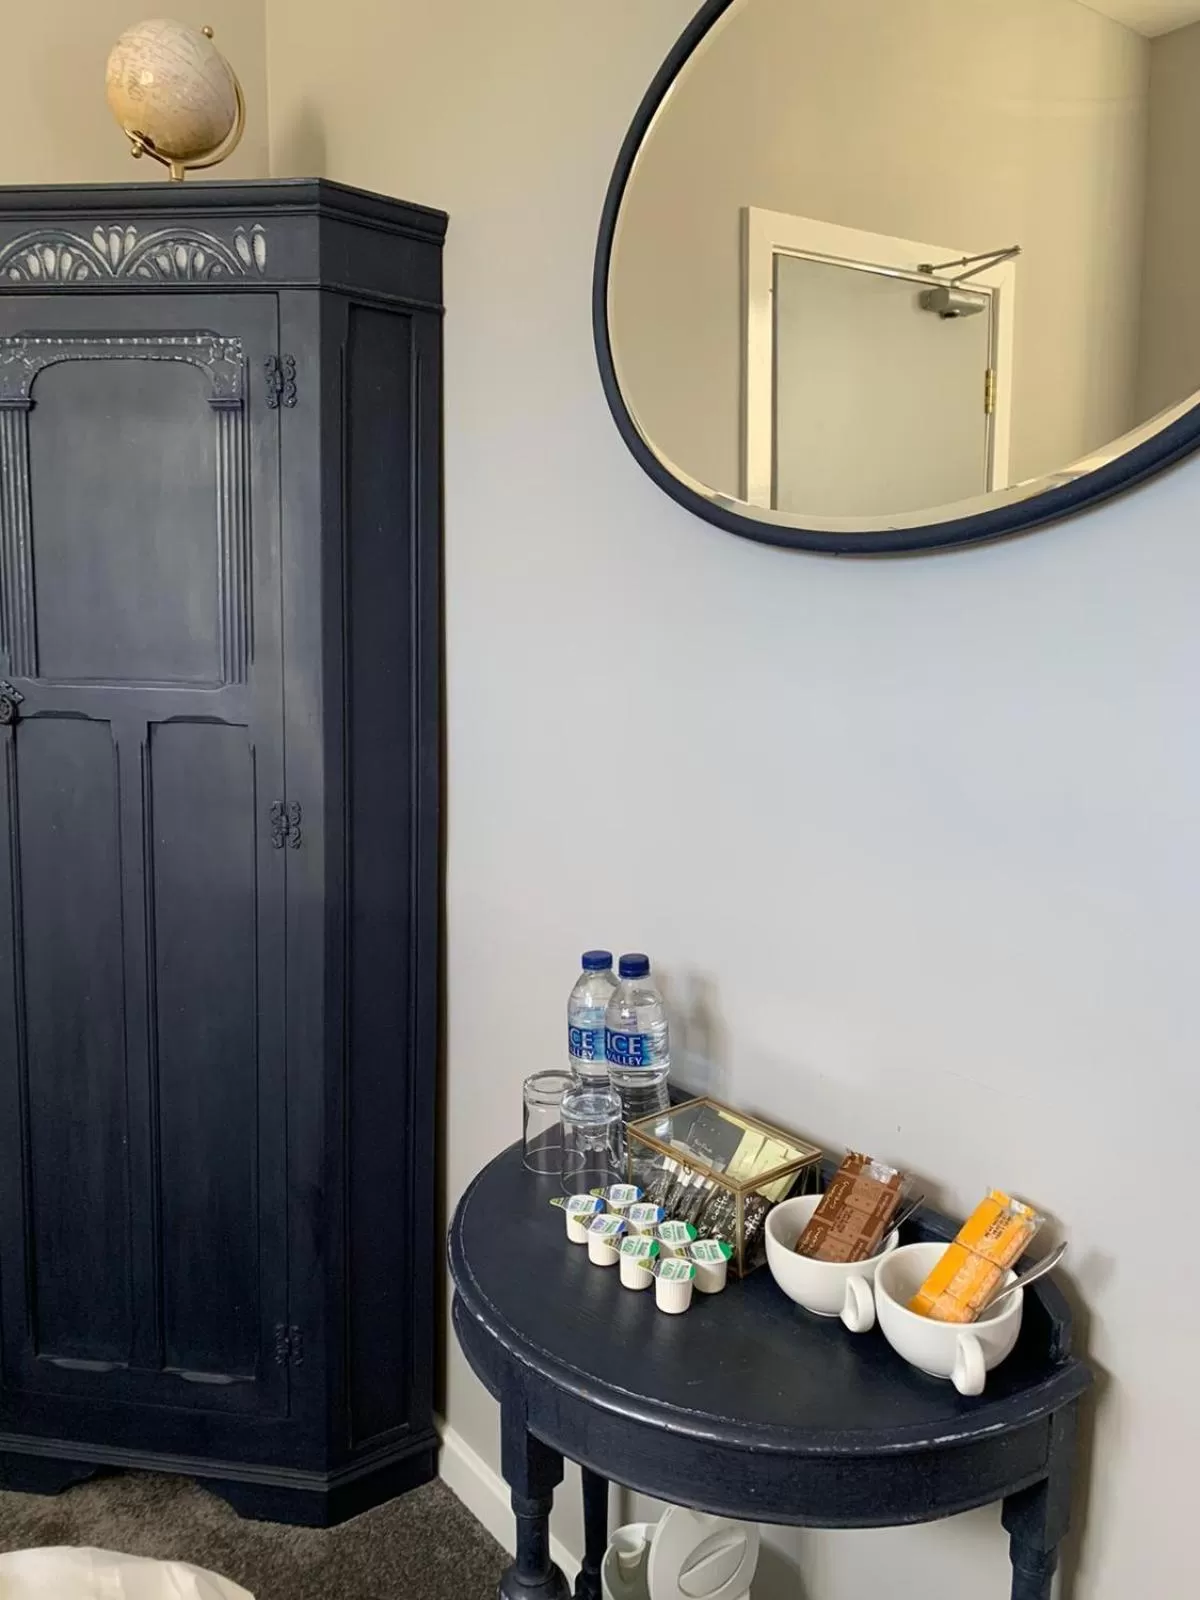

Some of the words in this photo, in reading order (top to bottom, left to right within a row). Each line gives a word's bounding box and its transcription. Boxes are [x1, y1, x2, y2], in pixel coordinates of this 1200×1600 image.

[570, 1027, 593, 1049] CE
[606, 1031, 641, 1055] ICE
[570, 1046, 594, 1060] LLEY
[606, 1049, 642, 1066] VALLEY
